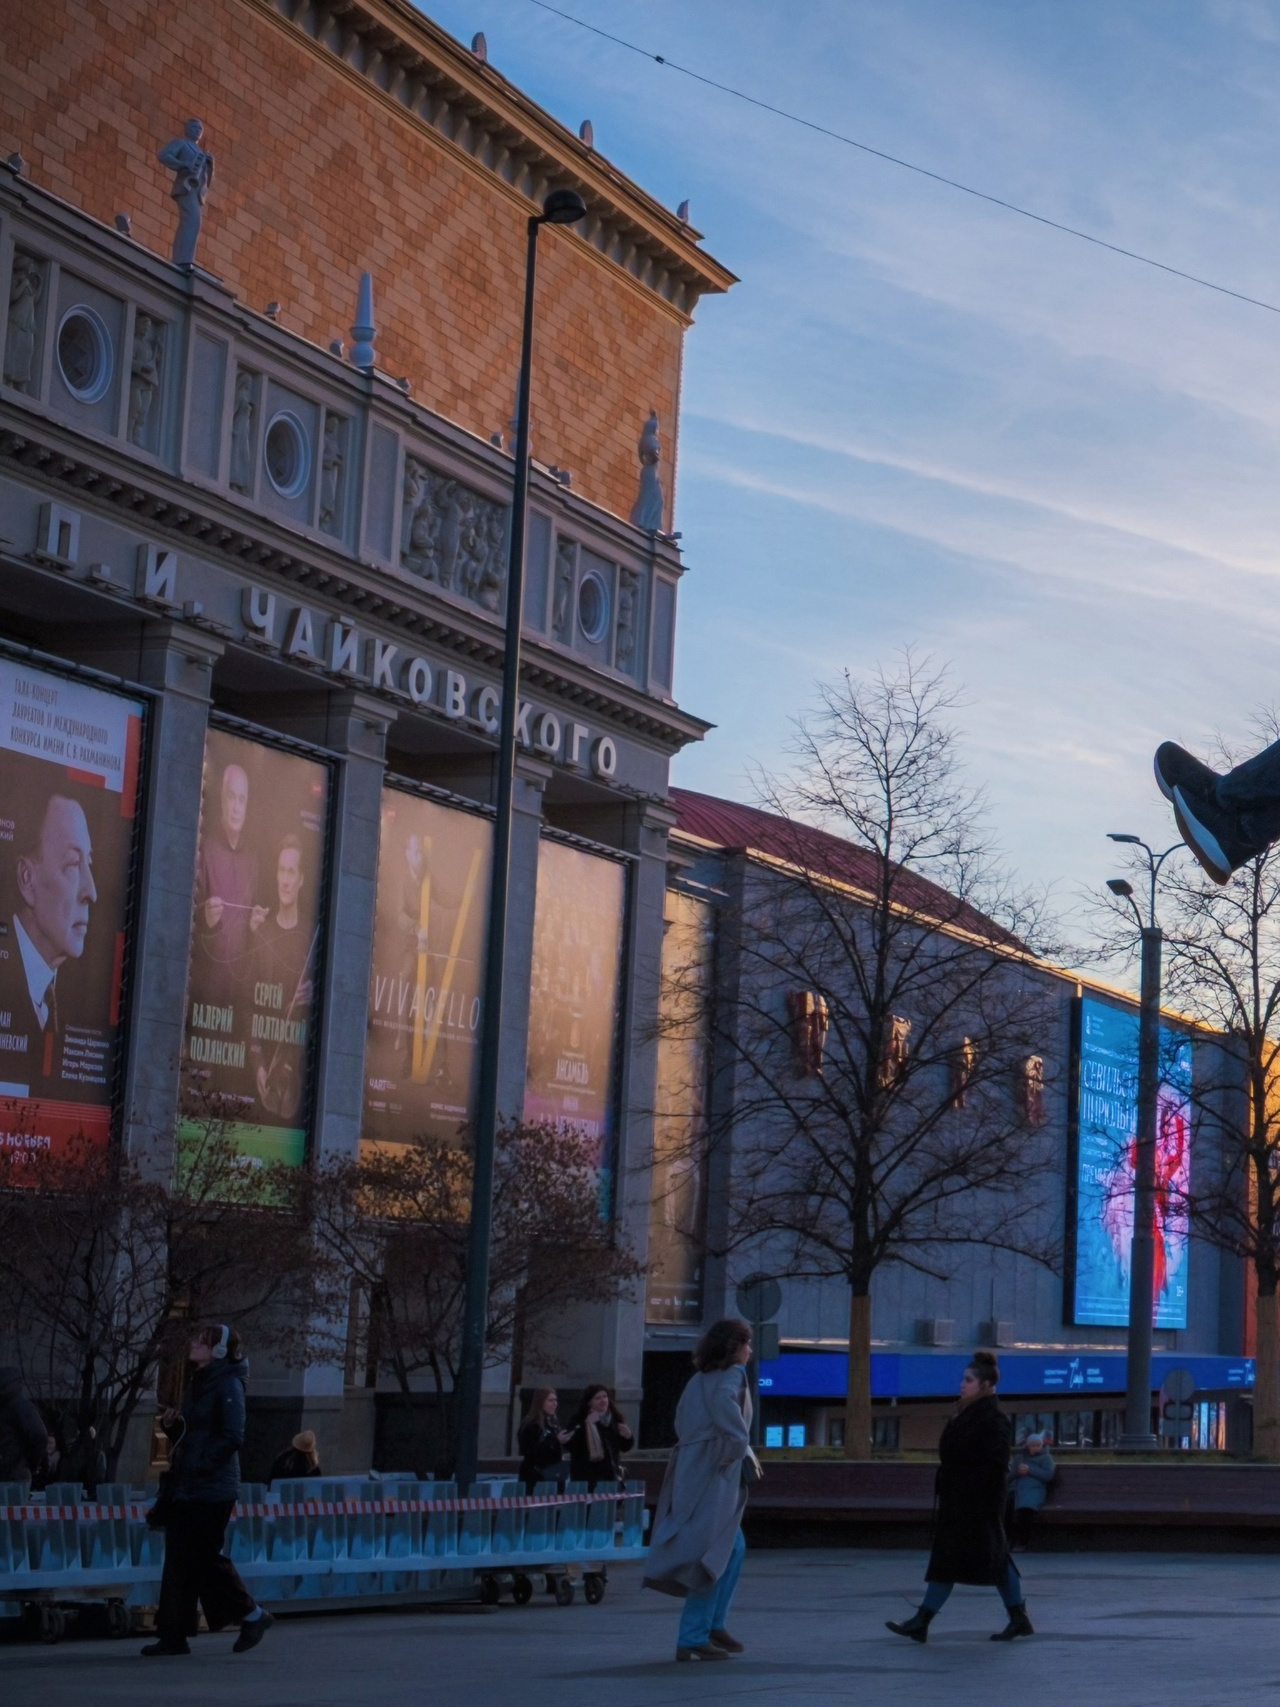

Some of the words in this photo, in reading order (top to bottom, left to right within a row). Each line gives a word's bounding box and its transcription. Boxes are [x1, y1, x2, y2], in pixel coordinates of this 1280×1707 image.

[37, 502, 112, 578] П.
[136, 543, 205, 615] И.
[242, 588, 617, 776] ЧАЙКОВСКОГО
[15, 678, 58, 707] ГАЛА-КОНЦЕРТ
[12, 702, 45, 727] ЛАУРЕАТОВ
[47, 712, 52, 728] II
[53, 715, 108, 745] МЕЖДУНАРОДНОГО
[10, 725, 41, 749] КОНКУРСА
[43, 735, 65, 756] ИМЕНИ
[79, 746, 121, 771] РАХМАНИНОВА
[254, 981, 284, 1010] СЕРГЕЙ
[374, 974, 481, 1032] VIVACELLO
[192, 1002, 234, 1034] ВАЛЕРИЙ
[251, 1013, 307, 1046] ПОЛТАВСКИЙ
[62, 1058, 79, 1069] Игорь
[79, 1060, 103, 1072] Морозов
[190, 1036, 246, 1068] ПОЛЯНСКИЙ
[61, 1070, 78, 1080] Елена
[78, 1073, 106, 1084] Кузнецова
